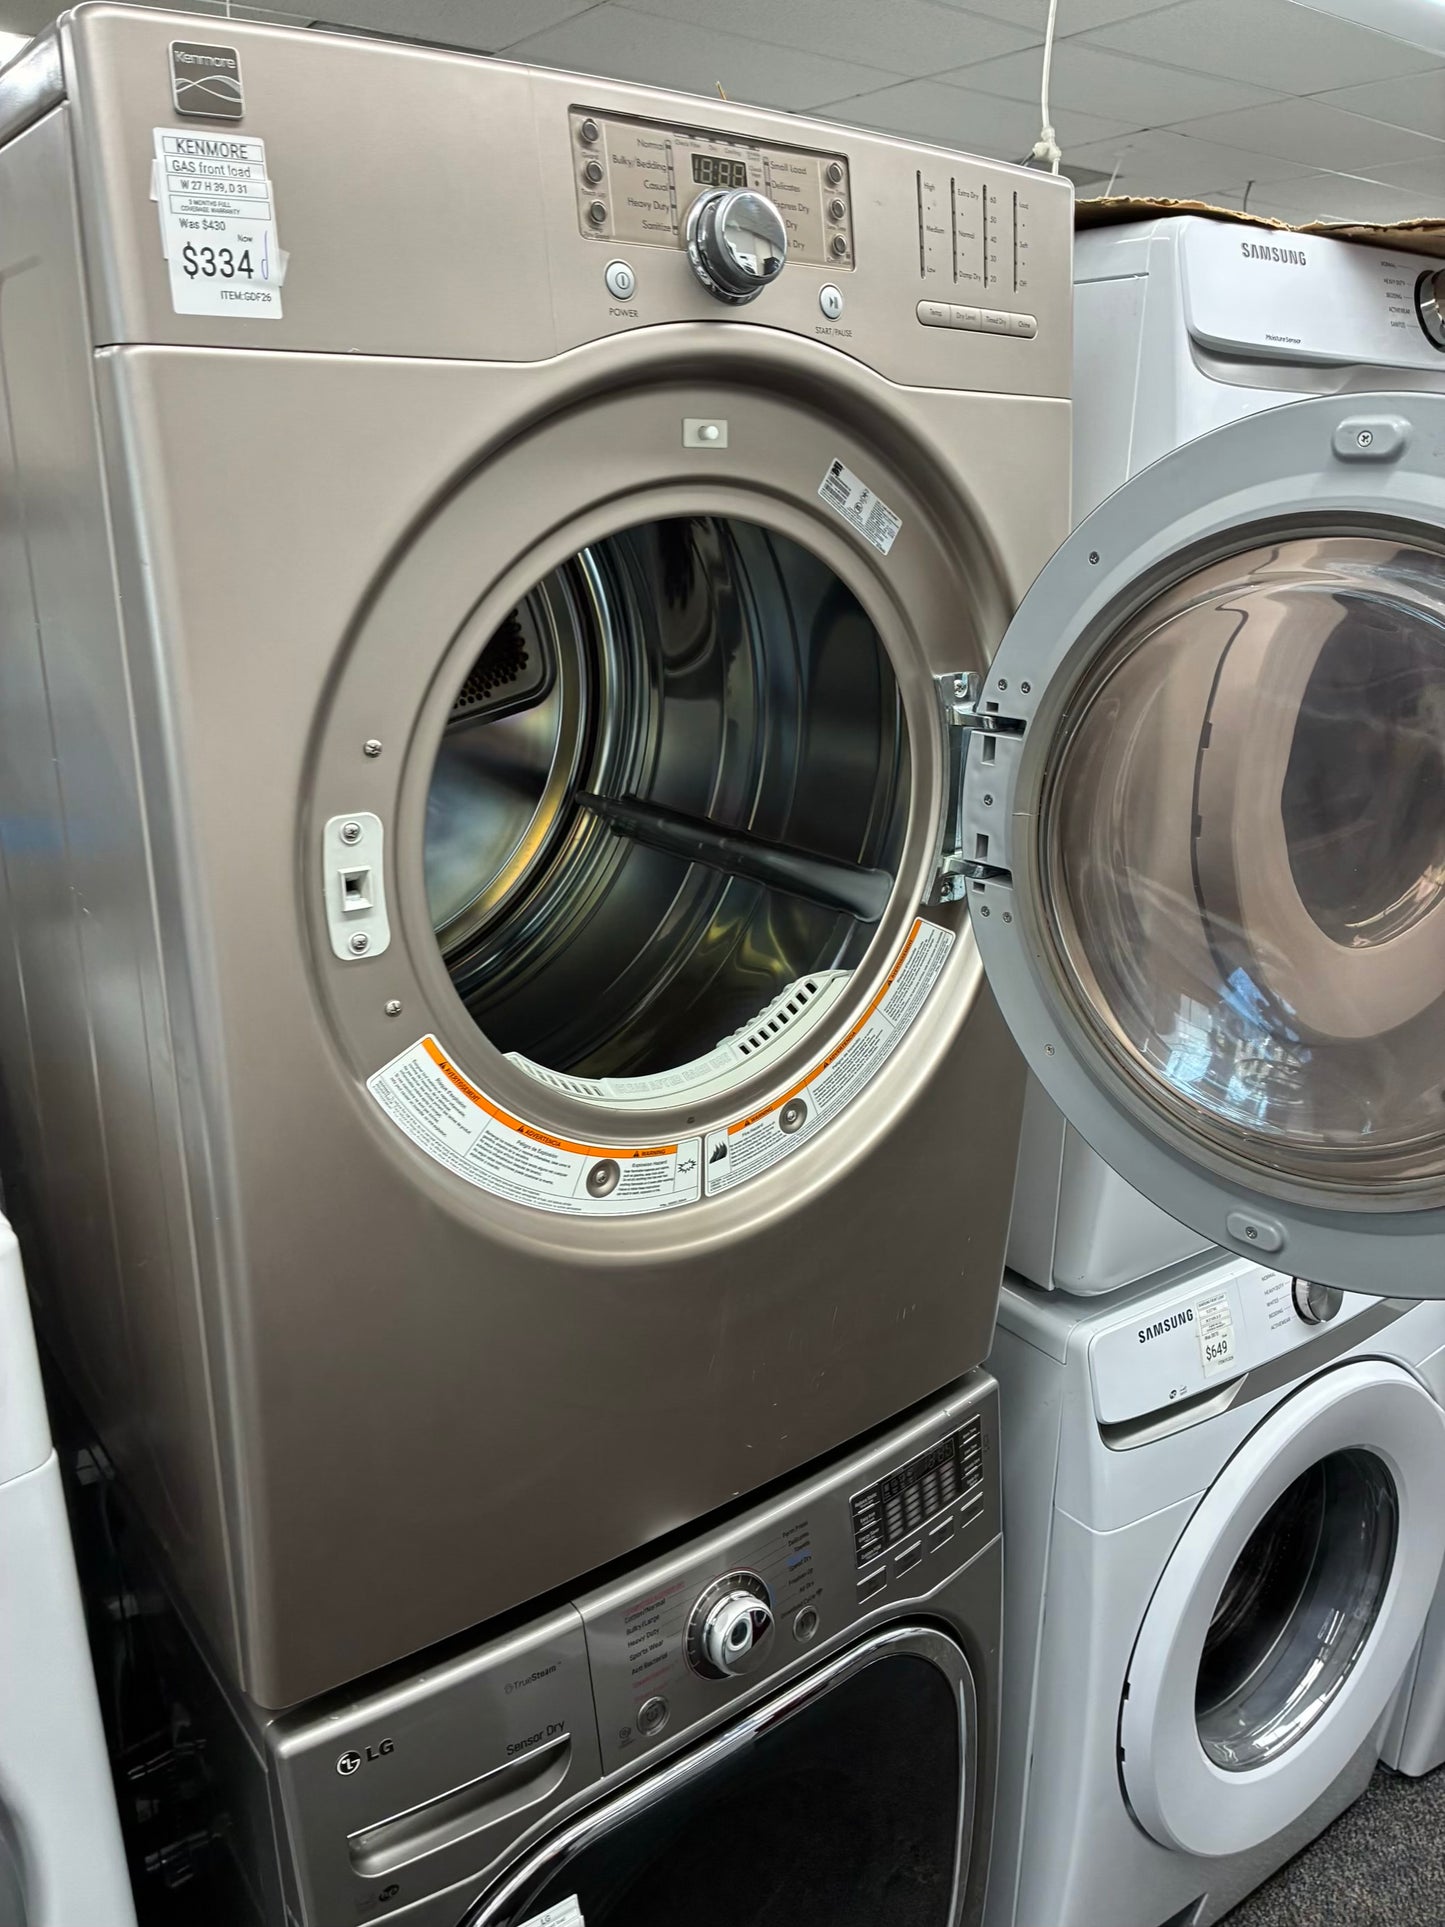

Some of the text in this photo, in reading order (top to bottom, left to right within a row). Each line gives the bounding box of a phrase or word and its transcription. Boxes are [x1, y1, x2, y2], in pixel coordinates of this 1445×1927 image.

[174, 50, 236, 69] Kenmore
[176, 138, 248, 160] KENMORE
[172, 160, 251, 178] GAS front load
[180, 179, 248, 194] W 27 H 39, D 31
[181, 205, 240, 215] COVERAGE WARRANTY
[193, 199, 217, 207] MONTHS
[798, 203, 809, 215] Dry
[179, 218, 226, 231] Was $430
[786, 219, 797, 231] Dry
[237, 234, 253, 242] Now
[793, 239, 804, 251] Dry
[183, 241, 254, 280] $334
[1241, 242, 1307, 266] SAMSUNG
[221, 290, 272, 302] ITEM:GDF26
[609, 307, 639, 318] POWER
[525, 1130, 561, 1147] ADVERTENCIA
[1138, 1308, 1194, 1344] SAMSUNG
[1205, 1340, 1228, 1362] $649
[627, 1634, 646, 1648] Heavy
[506, 1721, 565, 1756] Sensor Dry
[365, 1737, 394, 1762] LG
